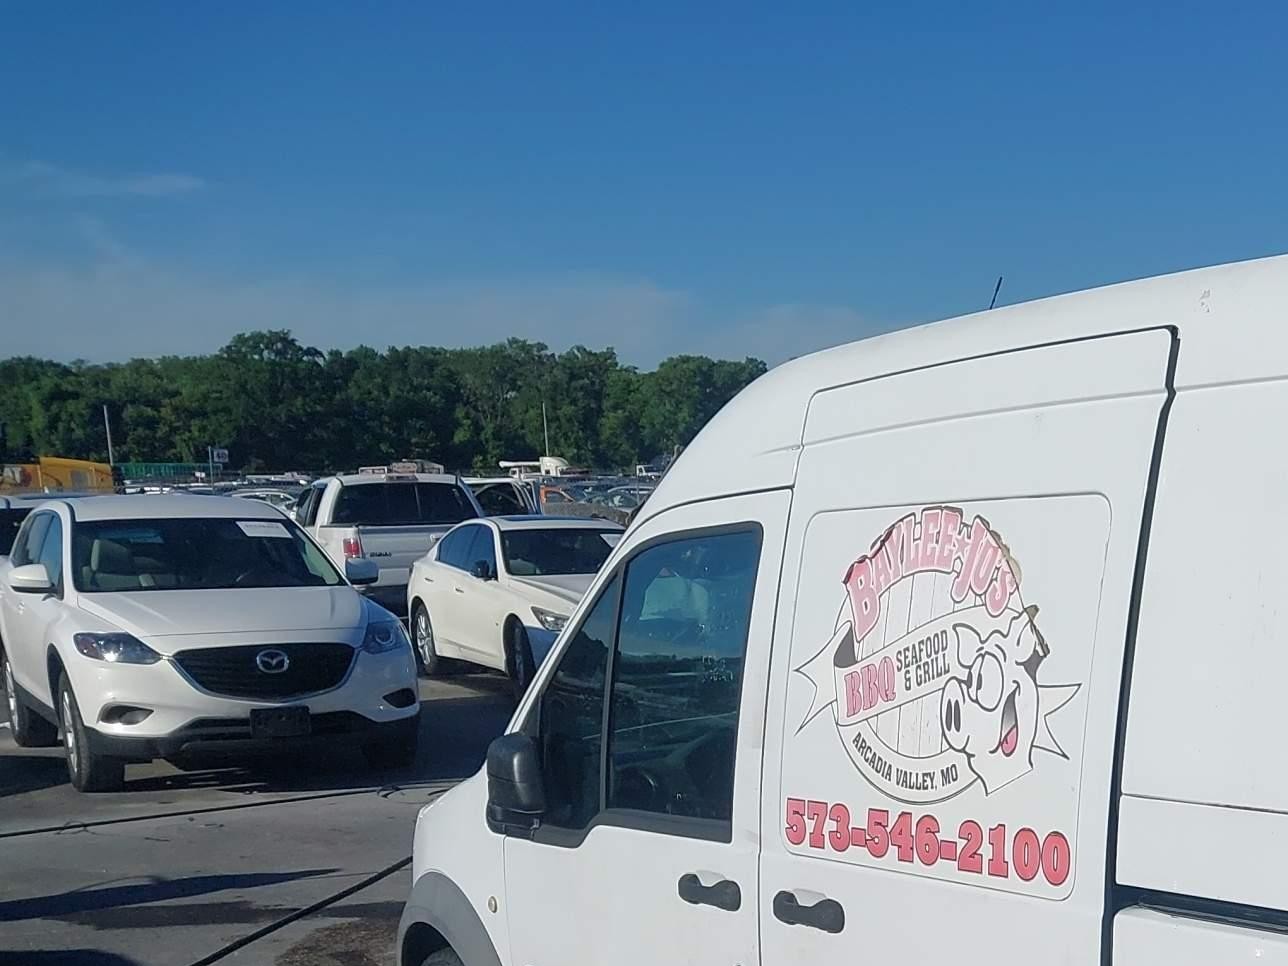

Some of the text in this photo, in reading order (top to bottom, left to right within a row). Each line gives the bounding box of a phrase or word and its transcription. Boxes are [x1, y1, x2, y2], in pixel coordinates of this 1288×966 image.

[846, 506, 963, 642] BAYLEE
[896, 630, 948, 672] SEAFOOD
[903, 653, 950, 691] & GRILL
[844, 656, 896, 718] BBQ
[852, 731, 893, 782] ARCADIA
[940, 763, 959, 787] MO
[785, 797, 1070, 886] 573-546-2100
